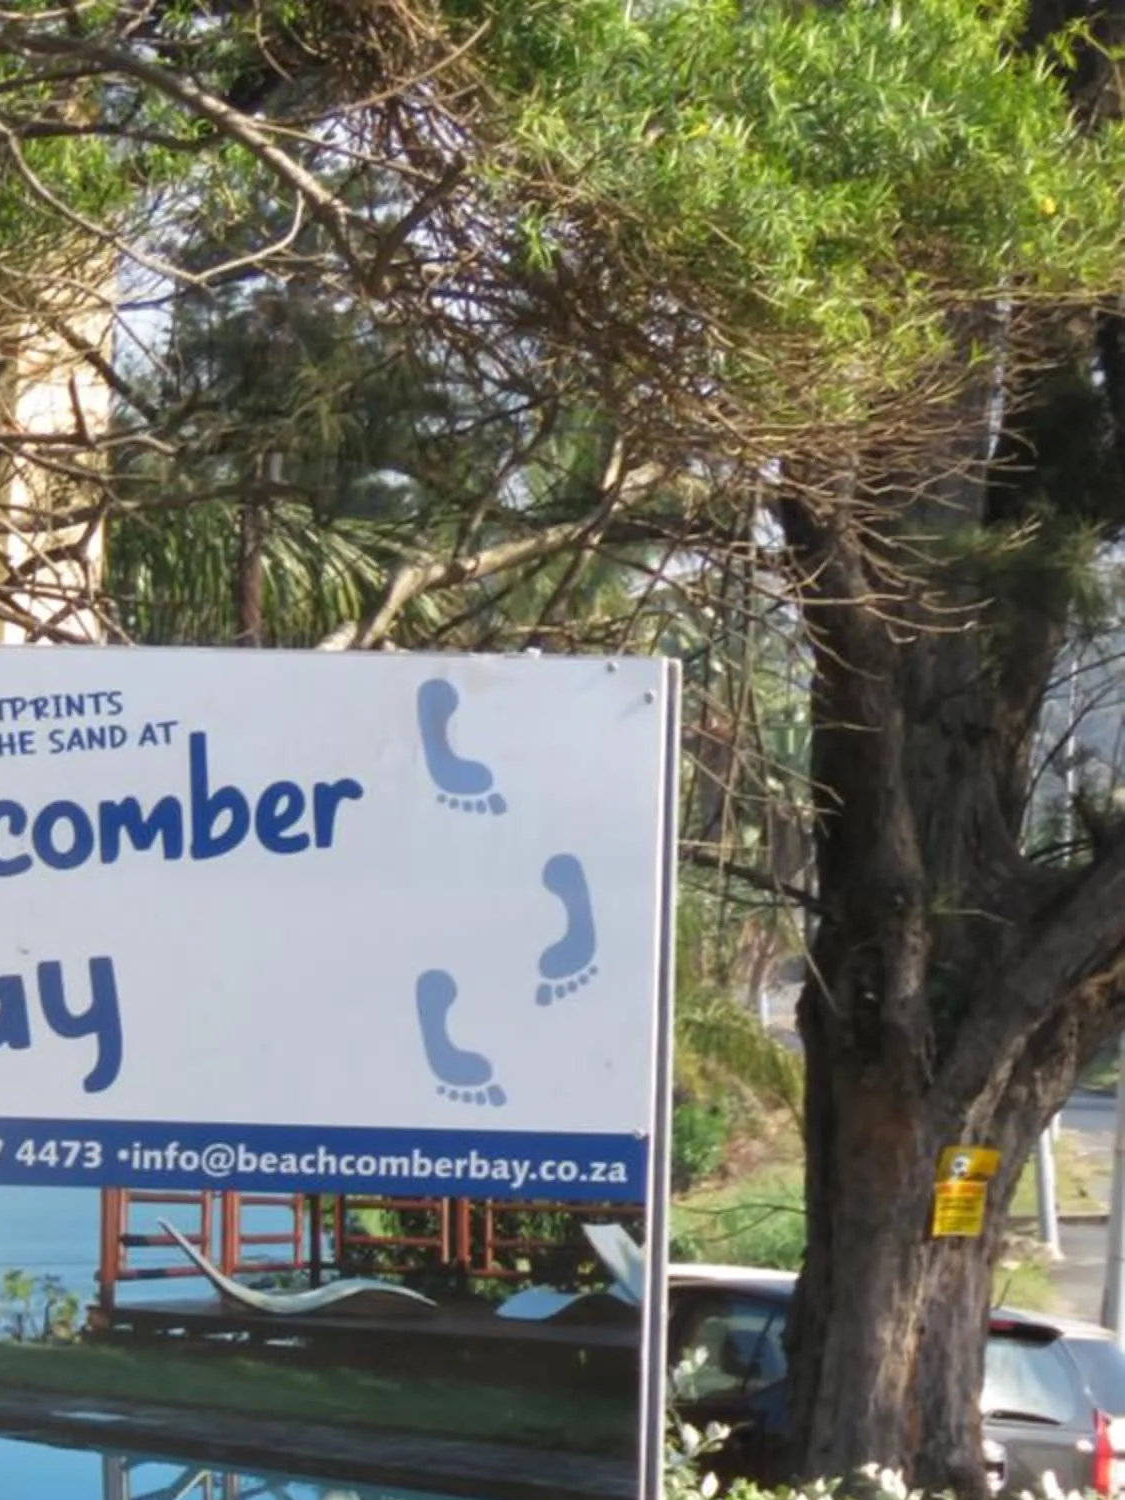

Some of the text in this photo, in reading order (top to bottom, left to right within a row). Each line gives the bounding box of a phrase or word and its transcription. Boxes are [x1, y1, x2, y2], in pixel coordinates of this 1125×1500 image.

[47, 725, 127, 755] SAND
[137, 720, 179, 746] AT
[14, 1139, 103, 1169] 4473
